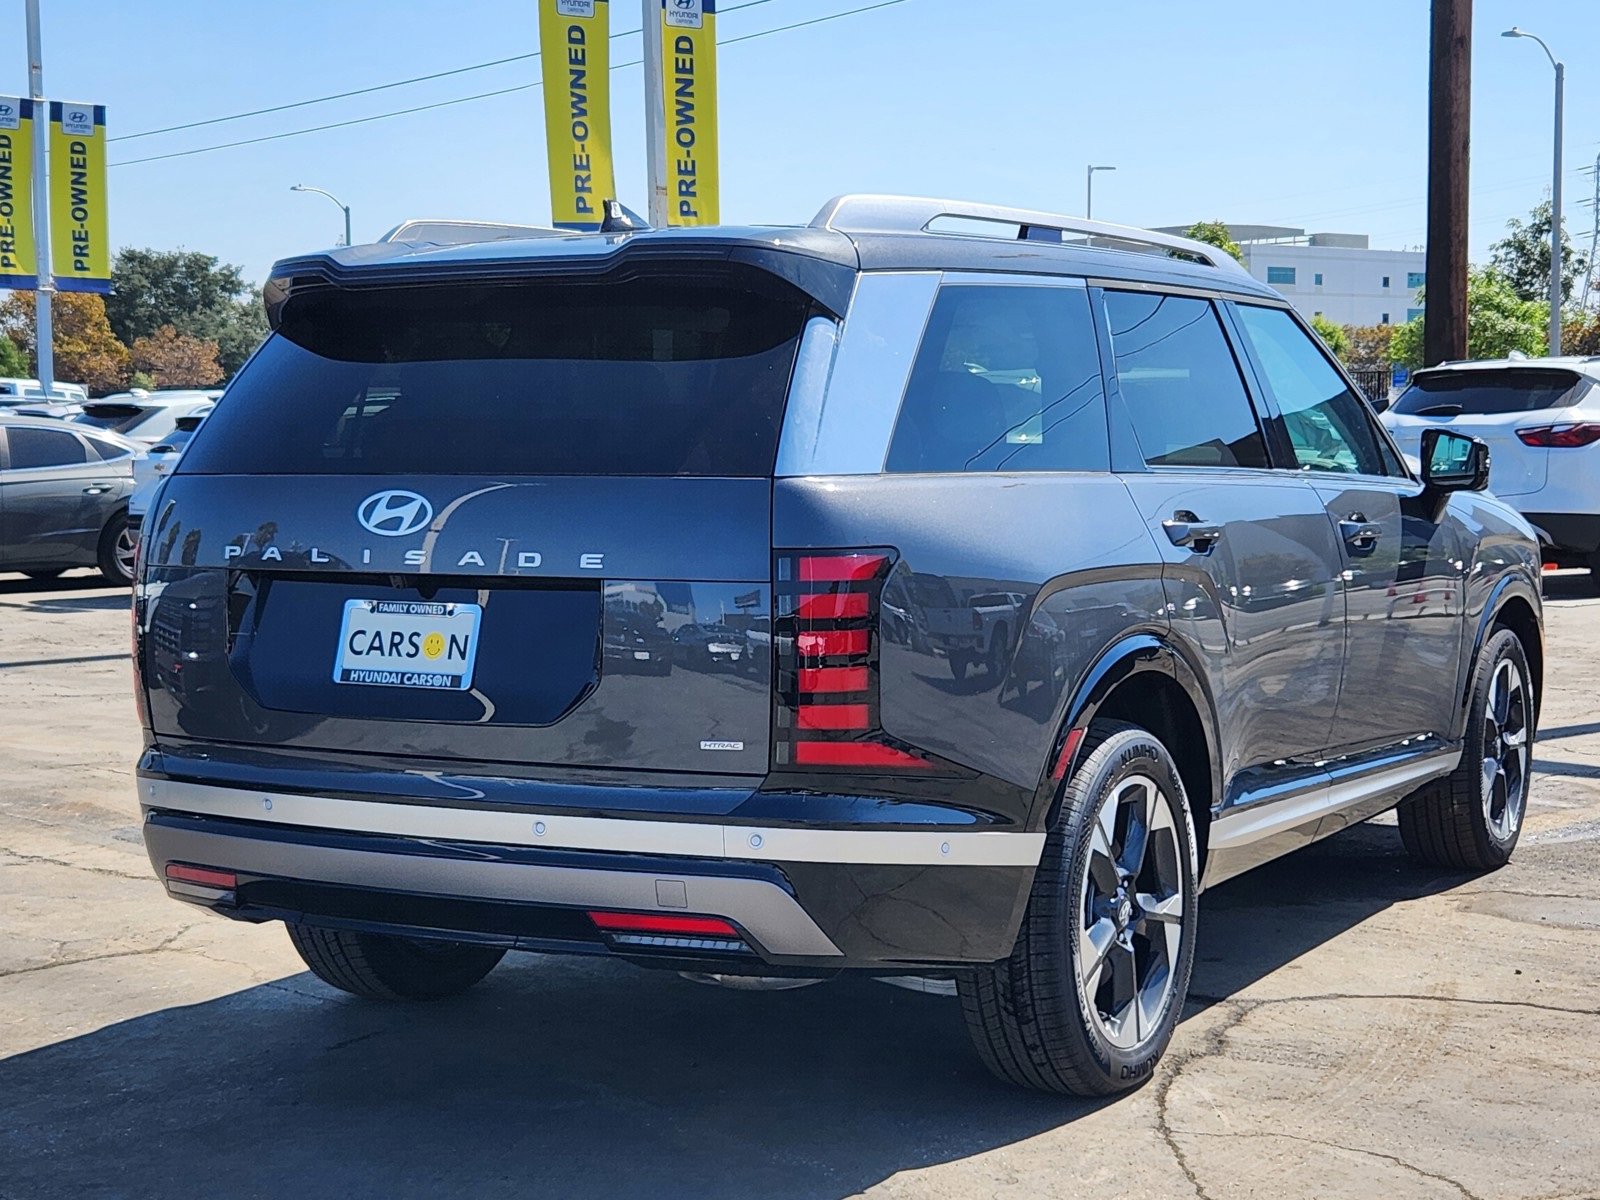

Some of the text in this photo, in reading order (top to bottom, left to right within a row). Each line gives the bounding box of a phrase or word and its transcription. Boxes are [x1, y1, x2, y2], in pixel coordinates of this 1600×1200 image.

[669, 10, 698, 19] HYUNDAI
[567, 25, 594, 215] PRE-OWNED
[674, 35, 698, 218] PRE-OWNED
[0, 134, 17, 269] PRE-OWNED
[70, 141, 91, 272] PRE-OWNED
[224, 545, 605, 569] PALISADE
[378, 602, 445, 615] FAMILY OWNED
[348, 629, 470, 662] CARSON
[349, 670, 452, 687] HYUNDAI CARSON
[1120, 744, 1160, 767] KUMHO
